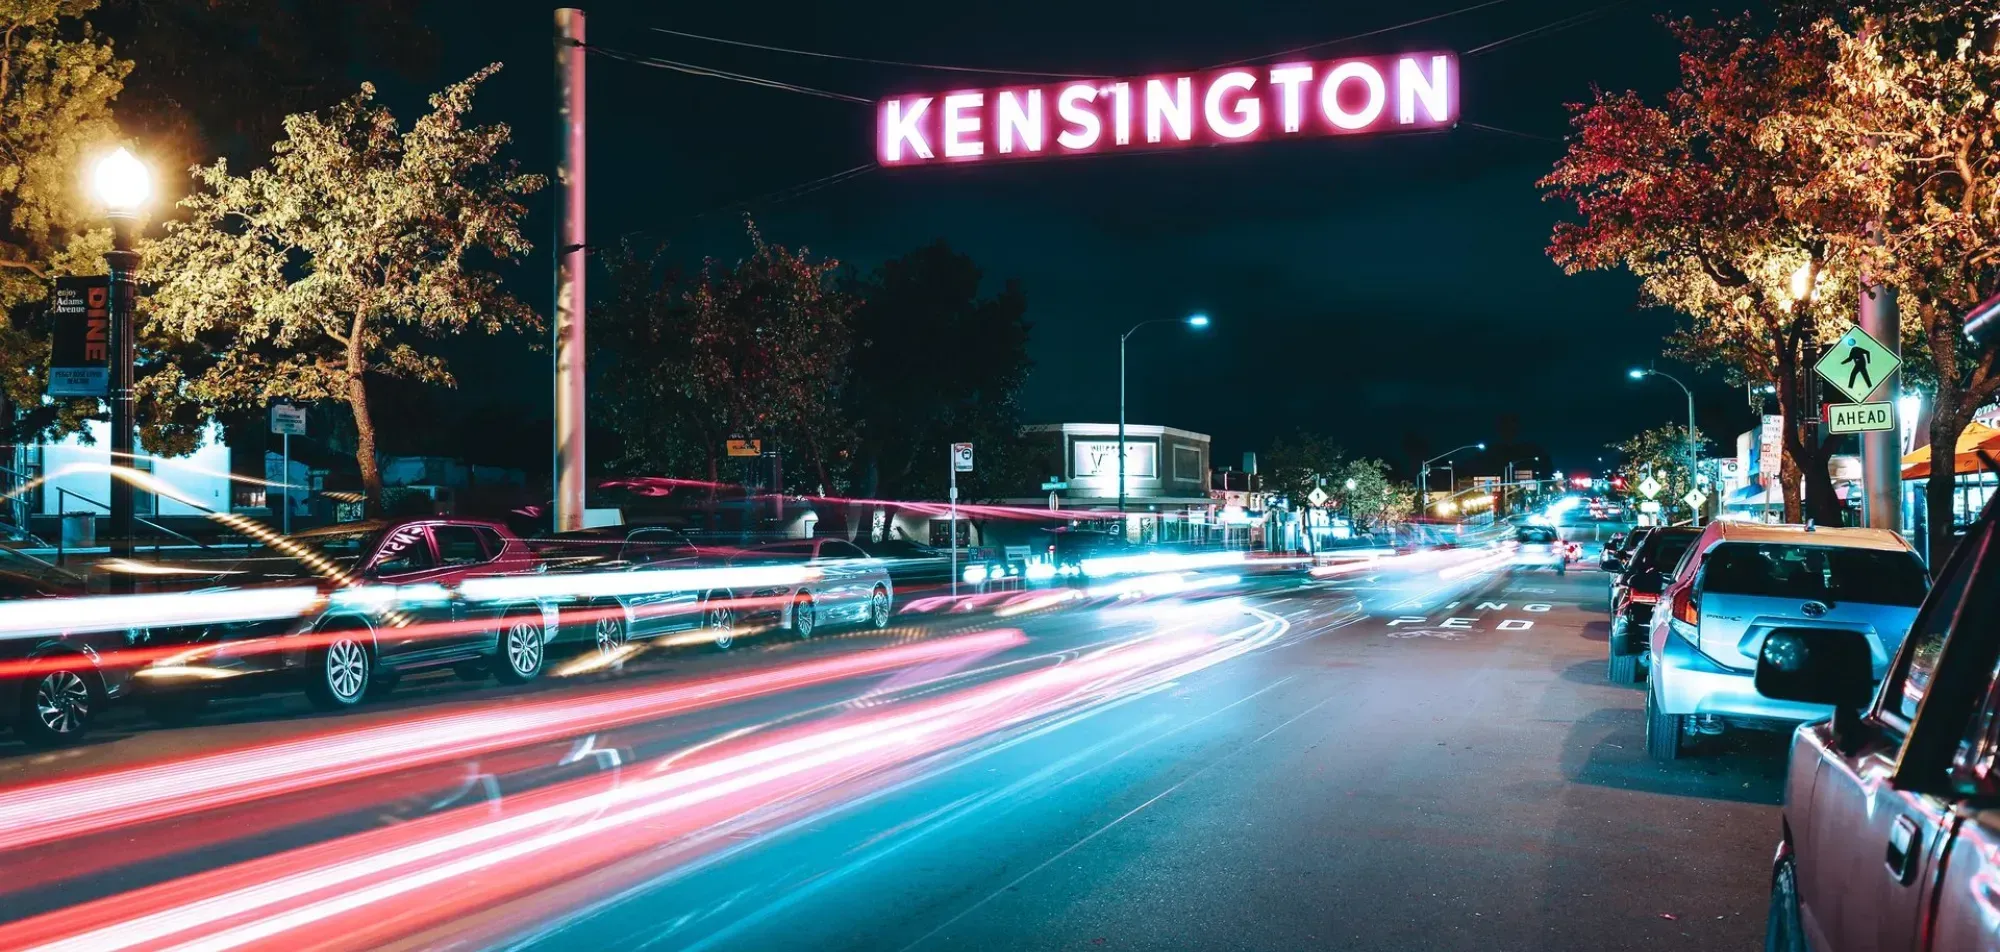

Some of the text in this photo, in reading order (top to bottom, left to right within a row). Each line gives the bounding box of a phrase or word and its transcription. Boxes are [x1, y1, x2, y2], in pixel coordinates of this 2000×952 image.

[887, 55, 1448, 161] KENSINGTON
[57, 289, 77, 298] enjoy
[57, 297, 84, 306] Adams
[56, 305, 86, 313] Avenue
[86, 287, 108, 361] DINE
[1836, 410, 1886, 425] AHEAD
[1386, 616, 1535, 630] PED
